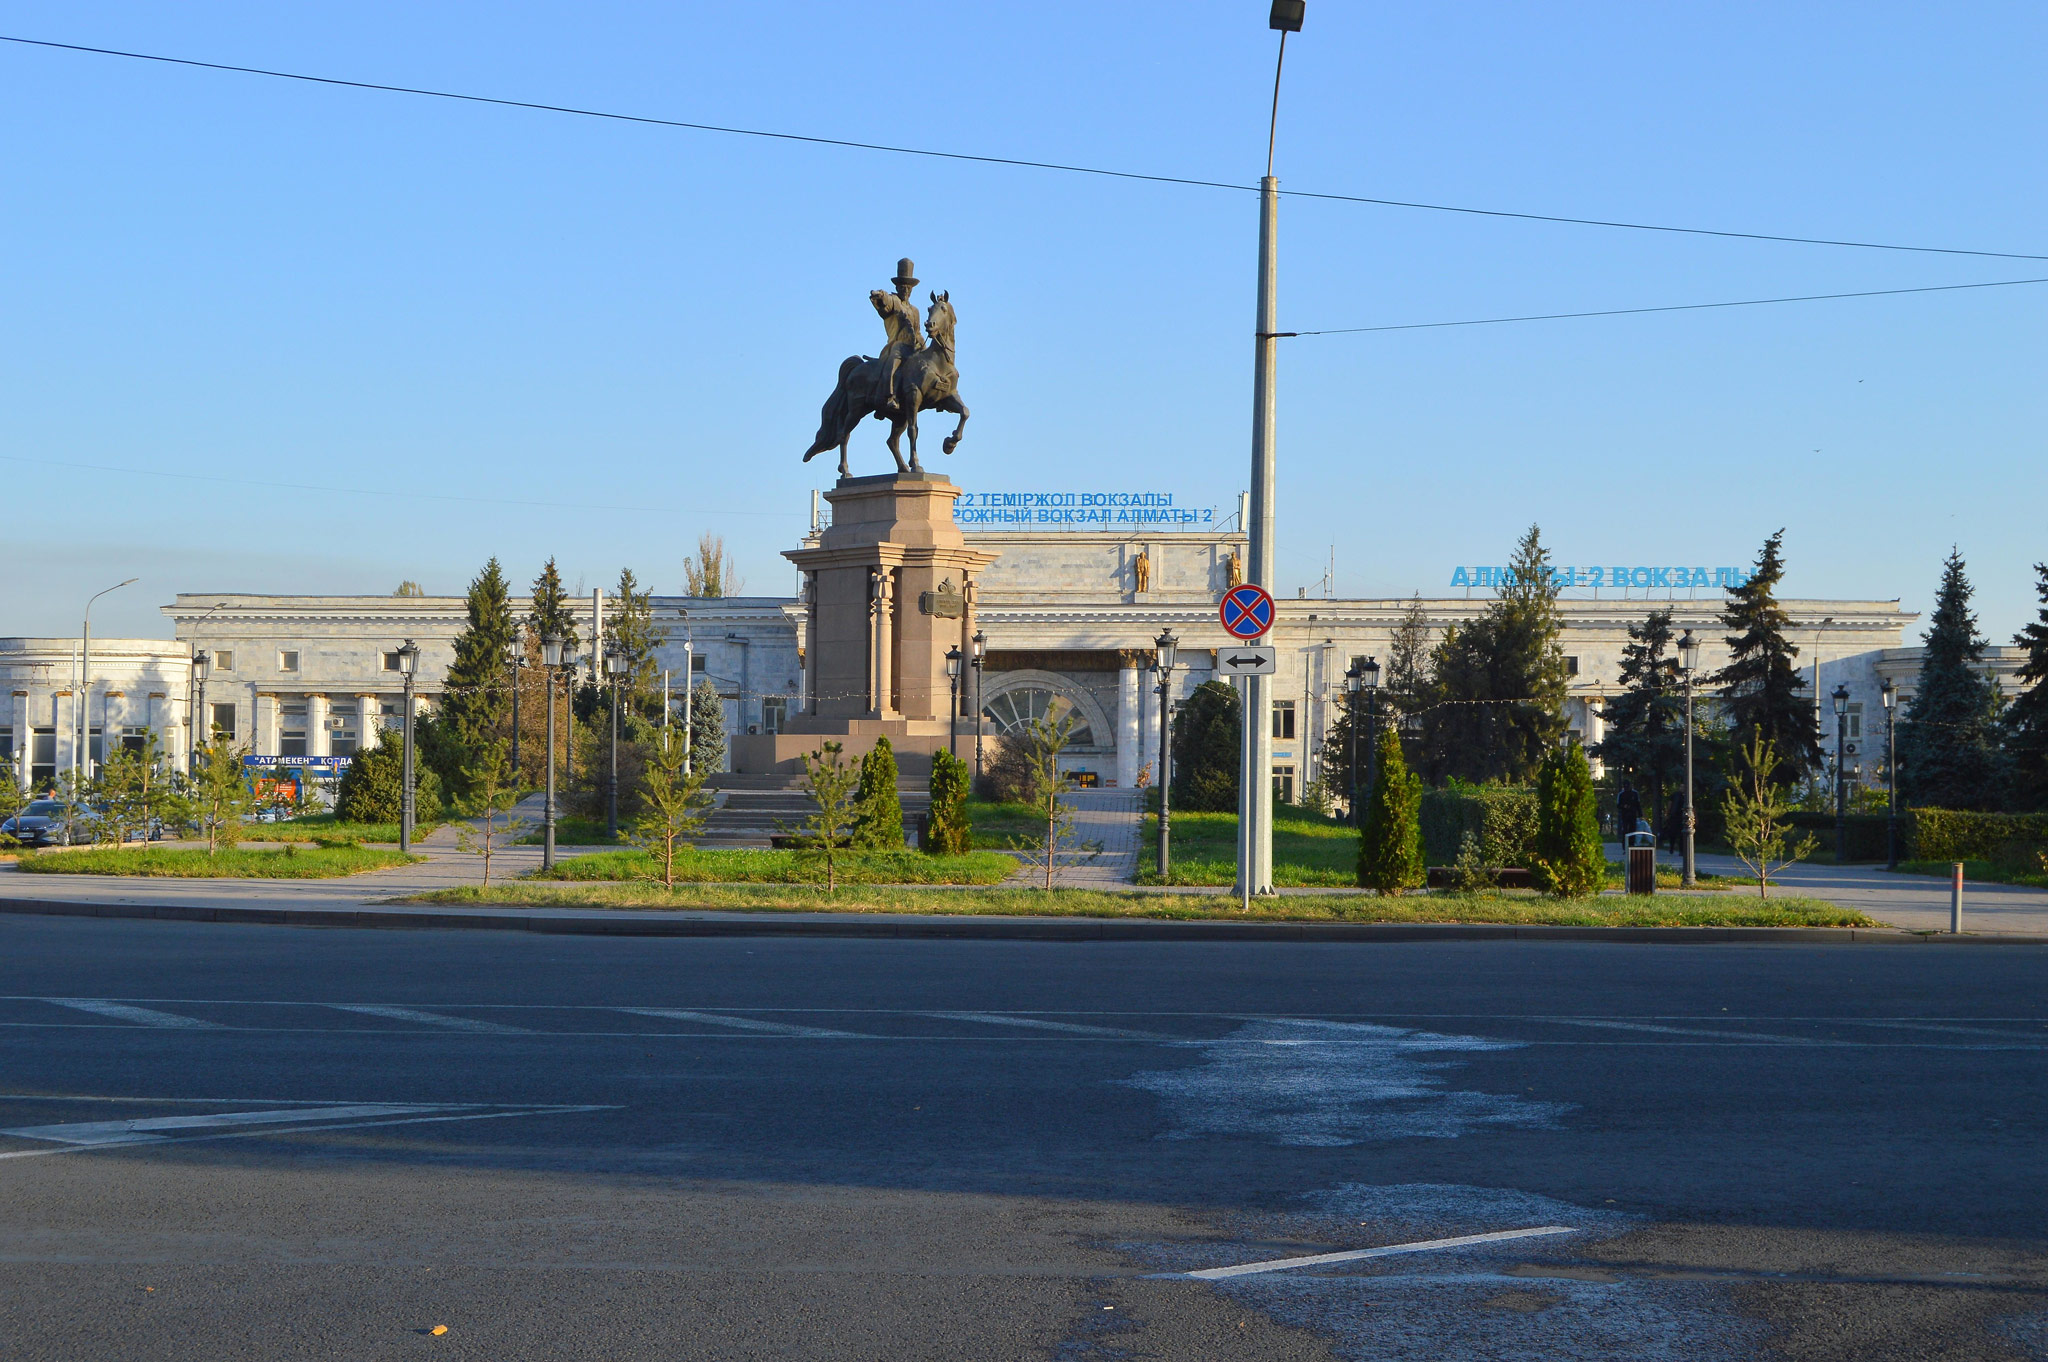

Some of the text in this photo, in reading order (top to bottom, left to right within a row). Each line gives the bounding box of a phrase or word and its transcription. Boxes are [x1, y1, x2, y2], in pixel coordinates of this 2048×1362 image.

[965, 493, 974, 506] 2
[1081, 493, 1172, 506] ВОКЗАЛЫ
[1038, 508, 1111, 522] ВОКЗАЛ
[1117, 508, 1197, 522] АЛМАТЫ
[1203, 508, 1212, 522] 2
[1450, 566, 1605, 588] АЛМЫ-2
[321, 756, 353, 766] ҚОДА
